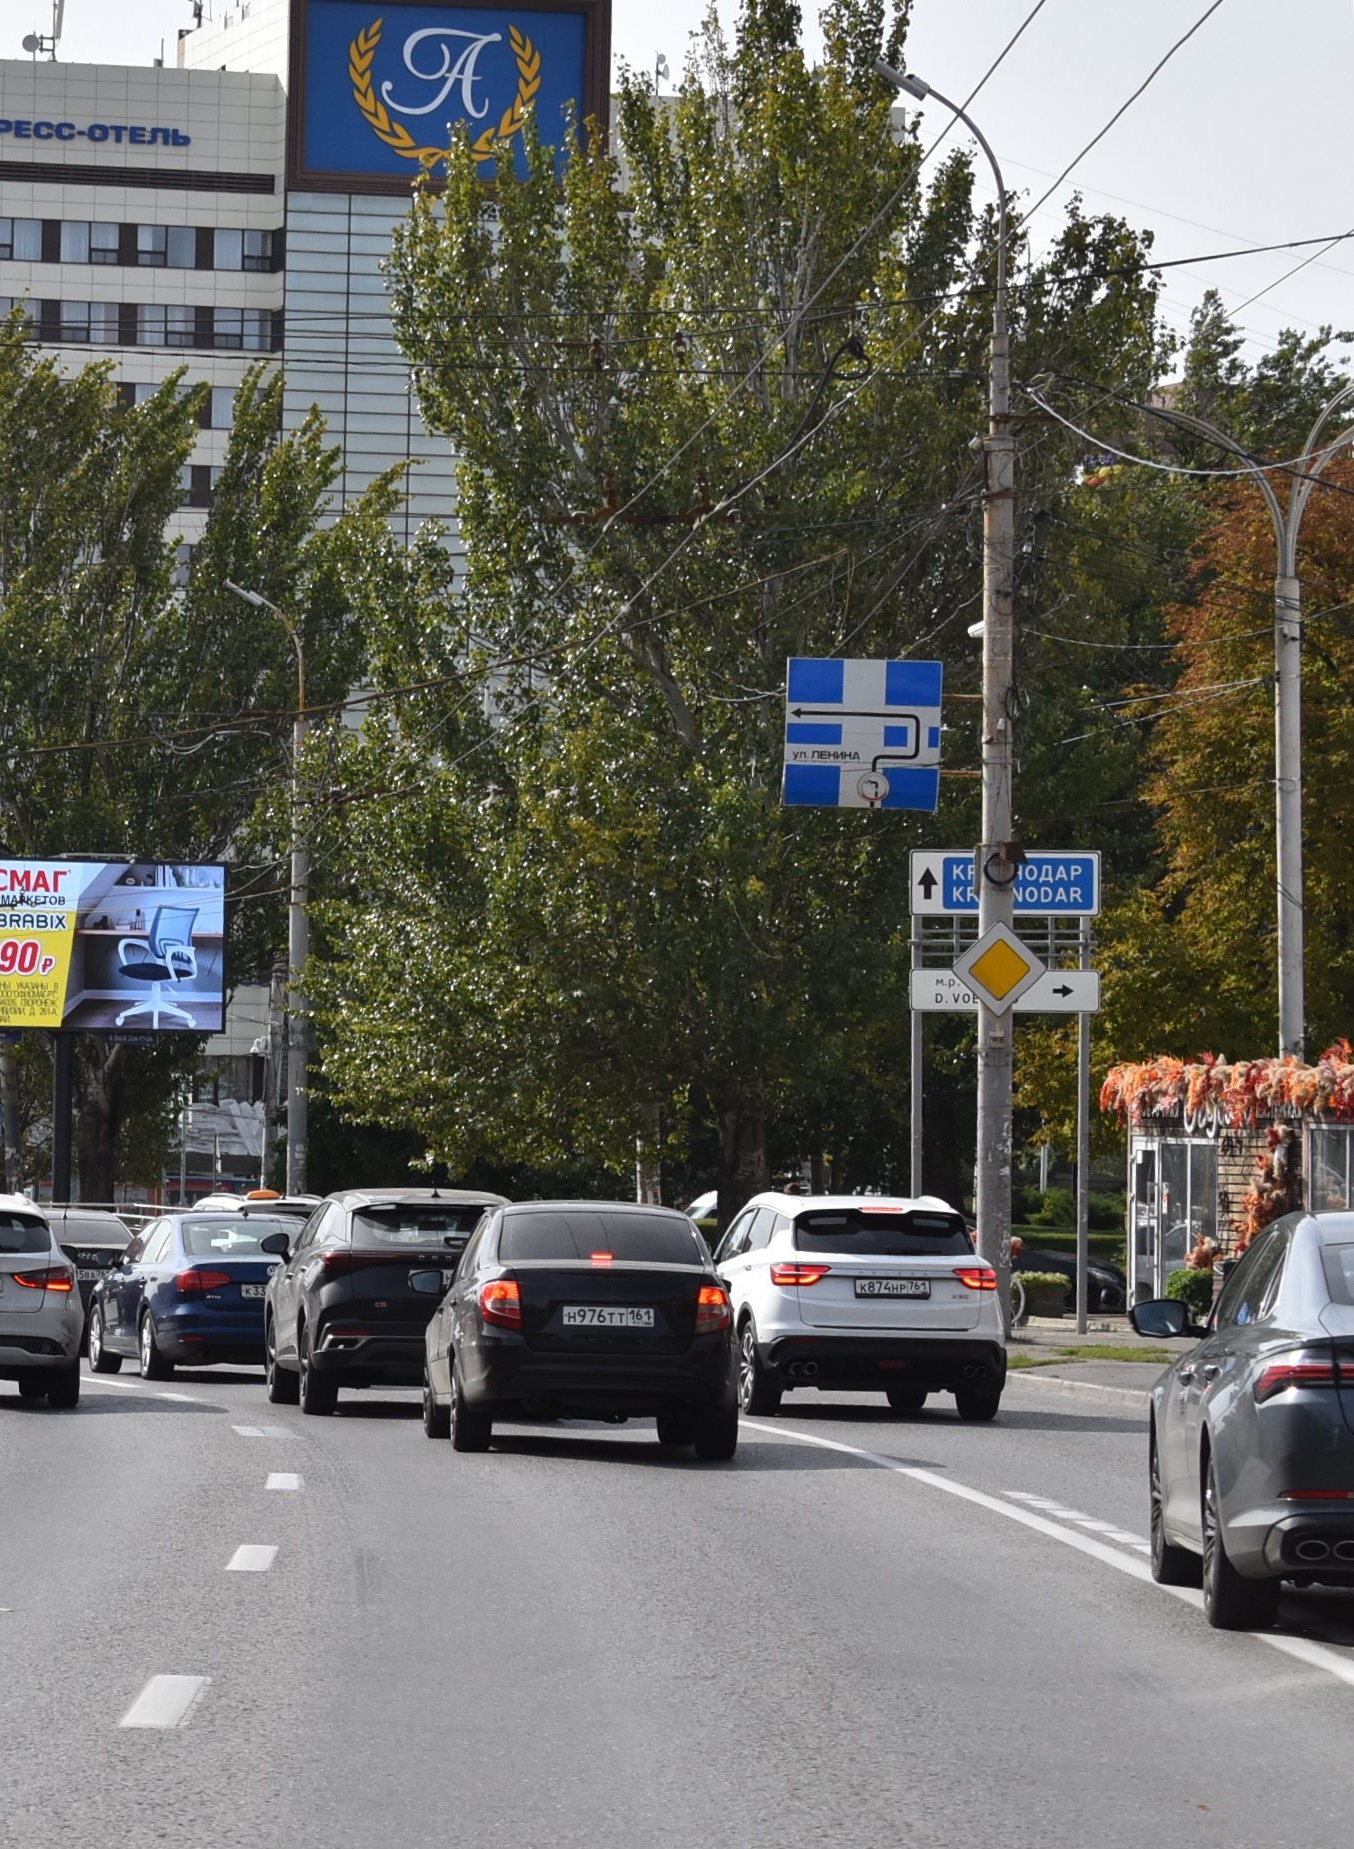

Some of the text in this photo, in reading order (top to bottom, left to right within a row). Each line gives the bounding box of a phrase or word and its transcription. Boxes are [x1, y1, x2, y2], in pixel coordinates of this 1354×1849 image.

[792, 750, 860, 760] ул. ЛЕНИНА
[952, 865, 1082, 883] КРНОДАР
[952, 887, 1084, 903] KRNODAR
